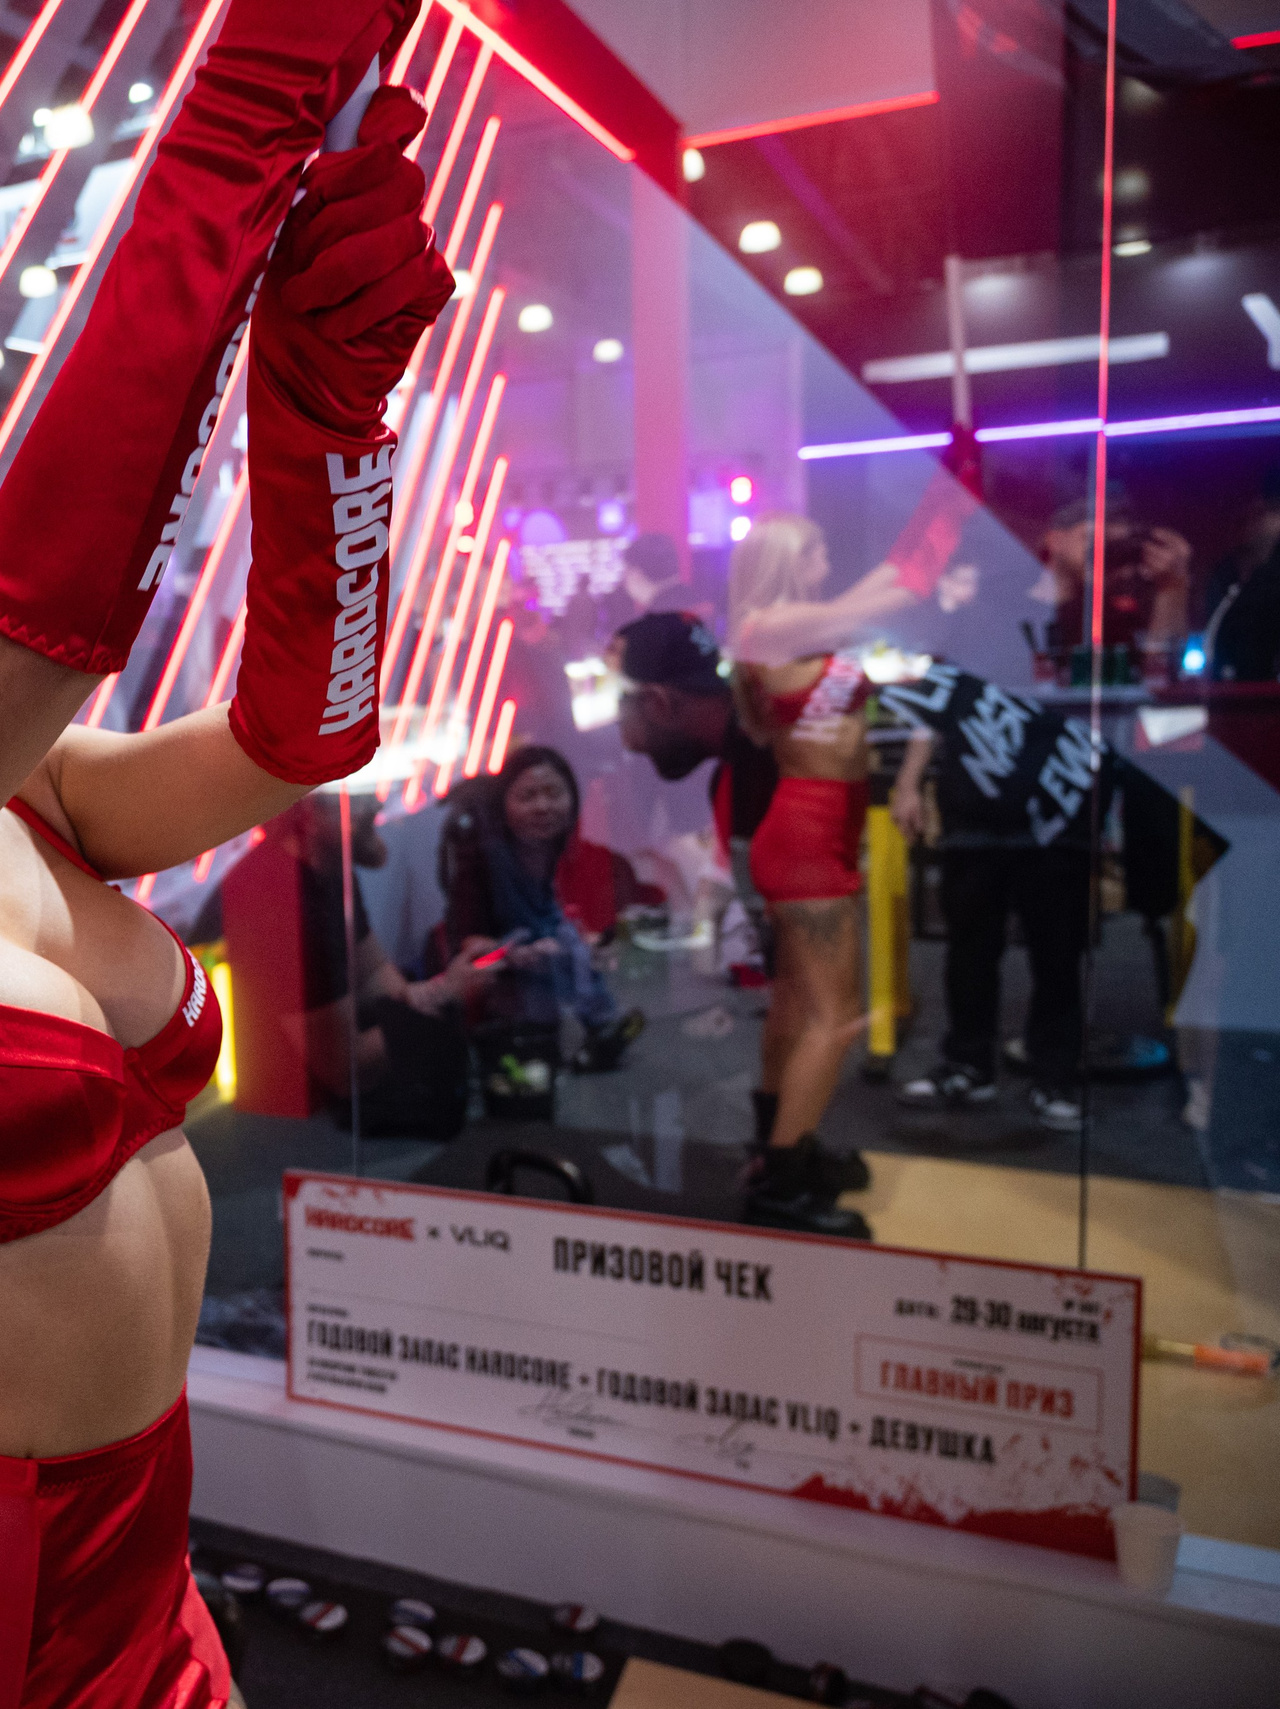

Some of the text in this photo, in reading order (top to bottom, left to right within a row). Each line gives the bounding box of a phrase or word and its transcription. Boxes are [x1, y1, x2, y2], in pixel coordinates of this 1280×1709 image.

[318, 444, 396, 735] HARDCORE
[449, 1223, 511, 1252] VLIQ
[553, 1235, 774, 1301] ПРИЗОВОЙ ЧЕК
[307, 1318, 392, 1358] ГОДОВОЙ
[398, 1334, 459, 1371] ЗАПАС
[596, 1366, 699, 1412] ГОДОВОЙ
[705, 1386, 779, 1428] ЗАПАС
[786, 1401, 840, 1442] VLIQ
[870, 1415, 997, 1466] ДЕВУШКА
[880, 1359, 1075, 1420] ГЛАВНЫЙ ПРИЗ
